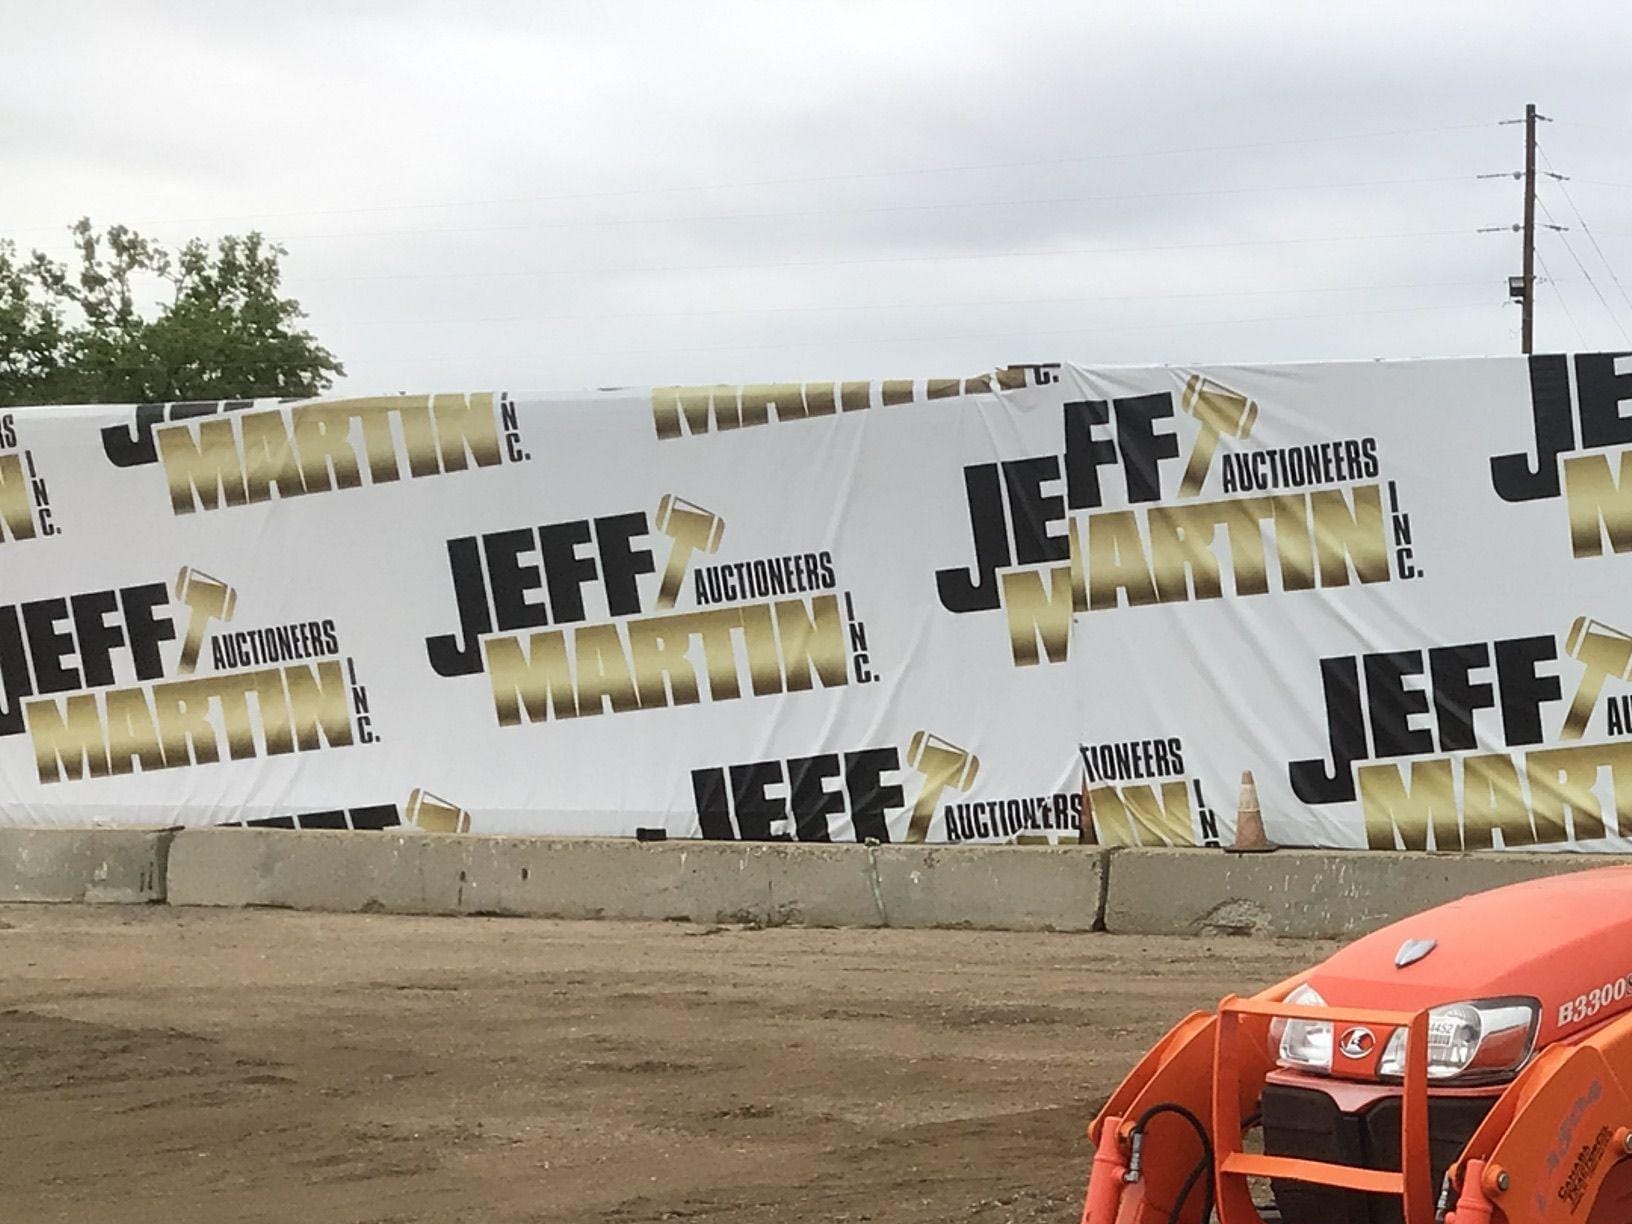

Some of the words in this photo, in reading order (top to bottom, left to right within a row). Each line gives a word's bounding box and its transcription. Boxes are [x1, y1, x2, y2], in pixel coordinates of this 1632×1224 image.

[157, 392, 502, 515] MARTIN
[500, 392, 531, 463] NC.
[1222, 437, 1379, 493] AUCTIONEERS
[935, 392, 1180, 613] JEFF
[426, 512, 656, 677] JEFF
[694, 551, 836, 606] AUCTIONEERS
[211, 619, 339, 671] AUCTIONEERS
[485, 594, 848, 727] MARTIN
[25, 659, 354, 784] MARTIN
[1289, 635, 1562, 804] JEFF
